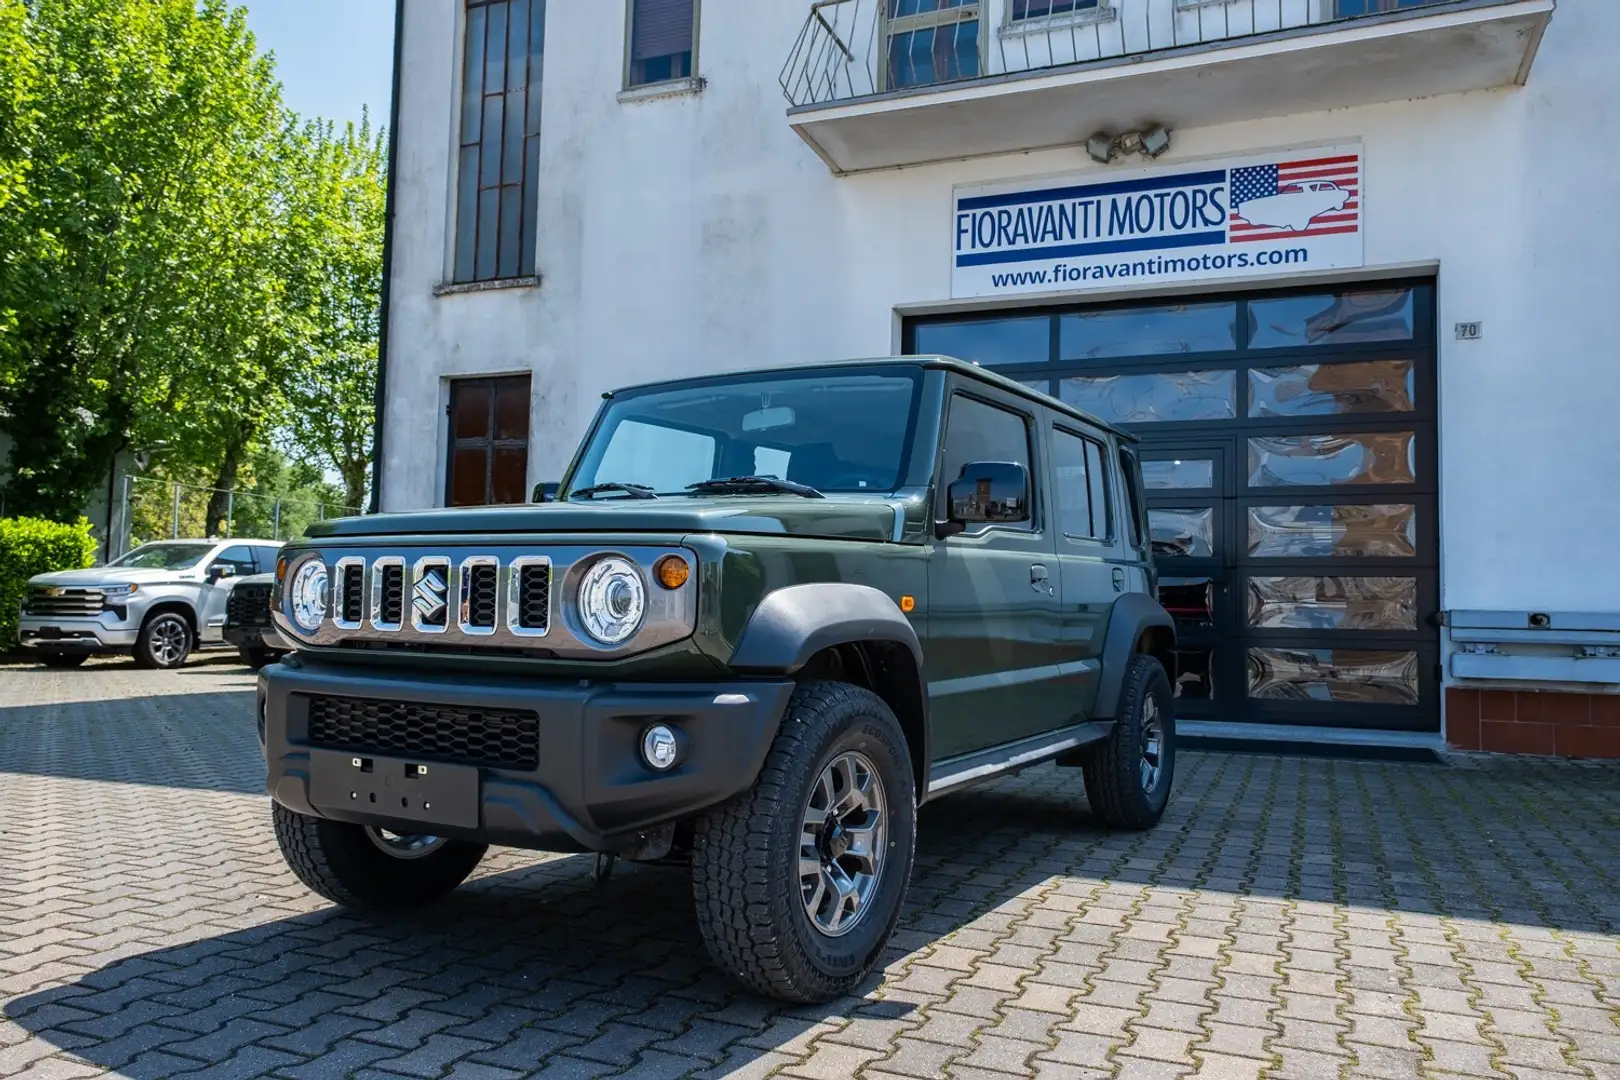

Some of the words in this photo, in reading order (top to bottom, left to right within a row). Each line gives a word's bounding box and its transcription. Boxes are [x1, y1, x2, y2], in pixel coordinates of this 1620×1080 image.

[956, 199, 1101, 251] FIORAVANTI
[1108, 187, 1226, 236] MOTORS
[992, 247, 1308, 287] www.fioravantimotors.com
[1460, 324, 1477, 337] 70
